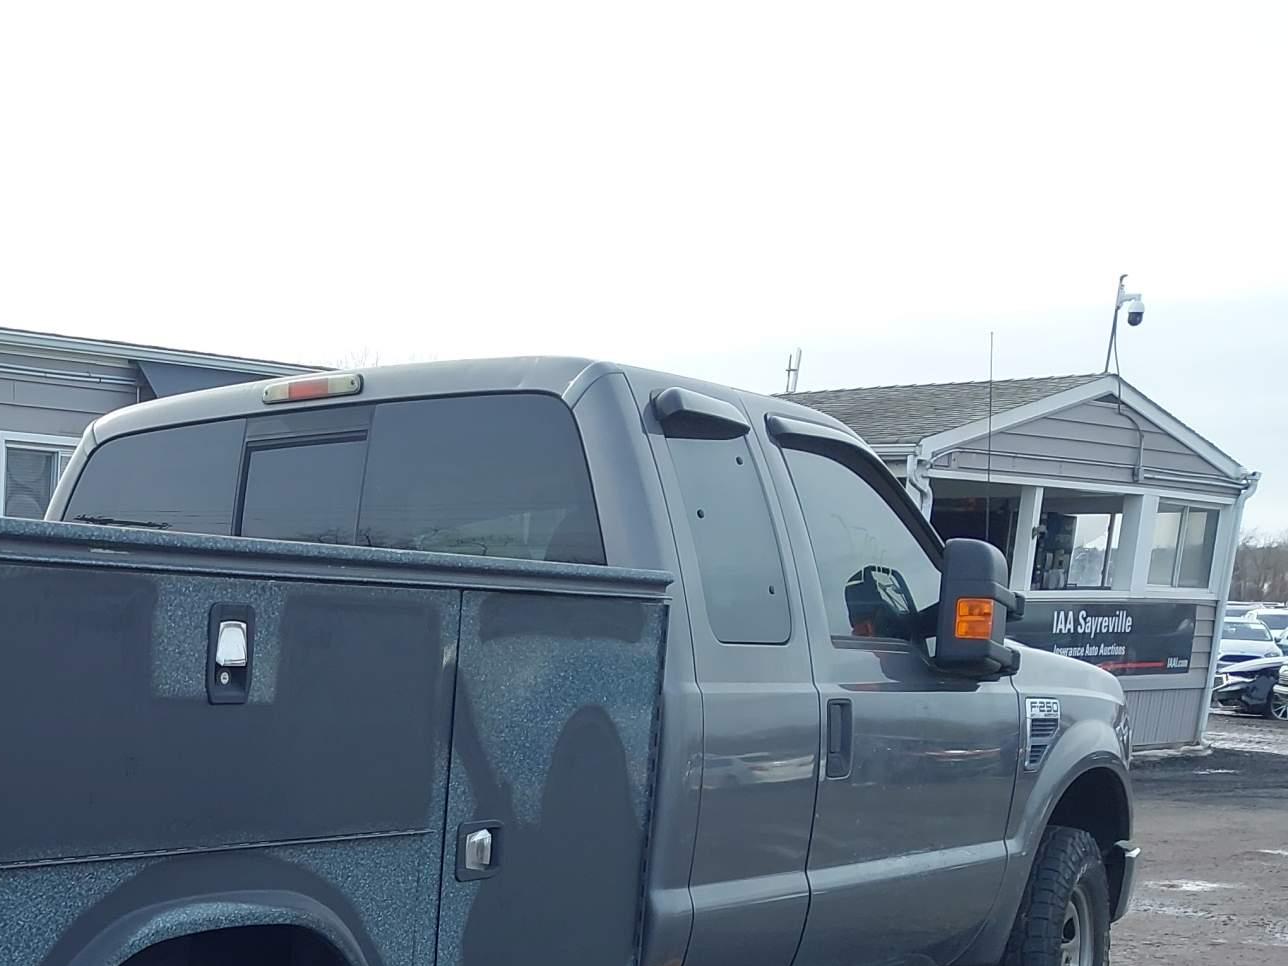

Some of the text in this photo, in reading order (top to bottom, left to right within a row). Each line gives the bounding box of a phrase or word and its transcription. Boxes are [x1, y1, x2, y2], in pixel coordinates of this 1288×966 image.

[1052, 609, 1132, 638] IAA Sayreville
[1053, 643, 1126, 657] Insurance Auto Auctions
[1030, 701, 1058, 713] F-250
